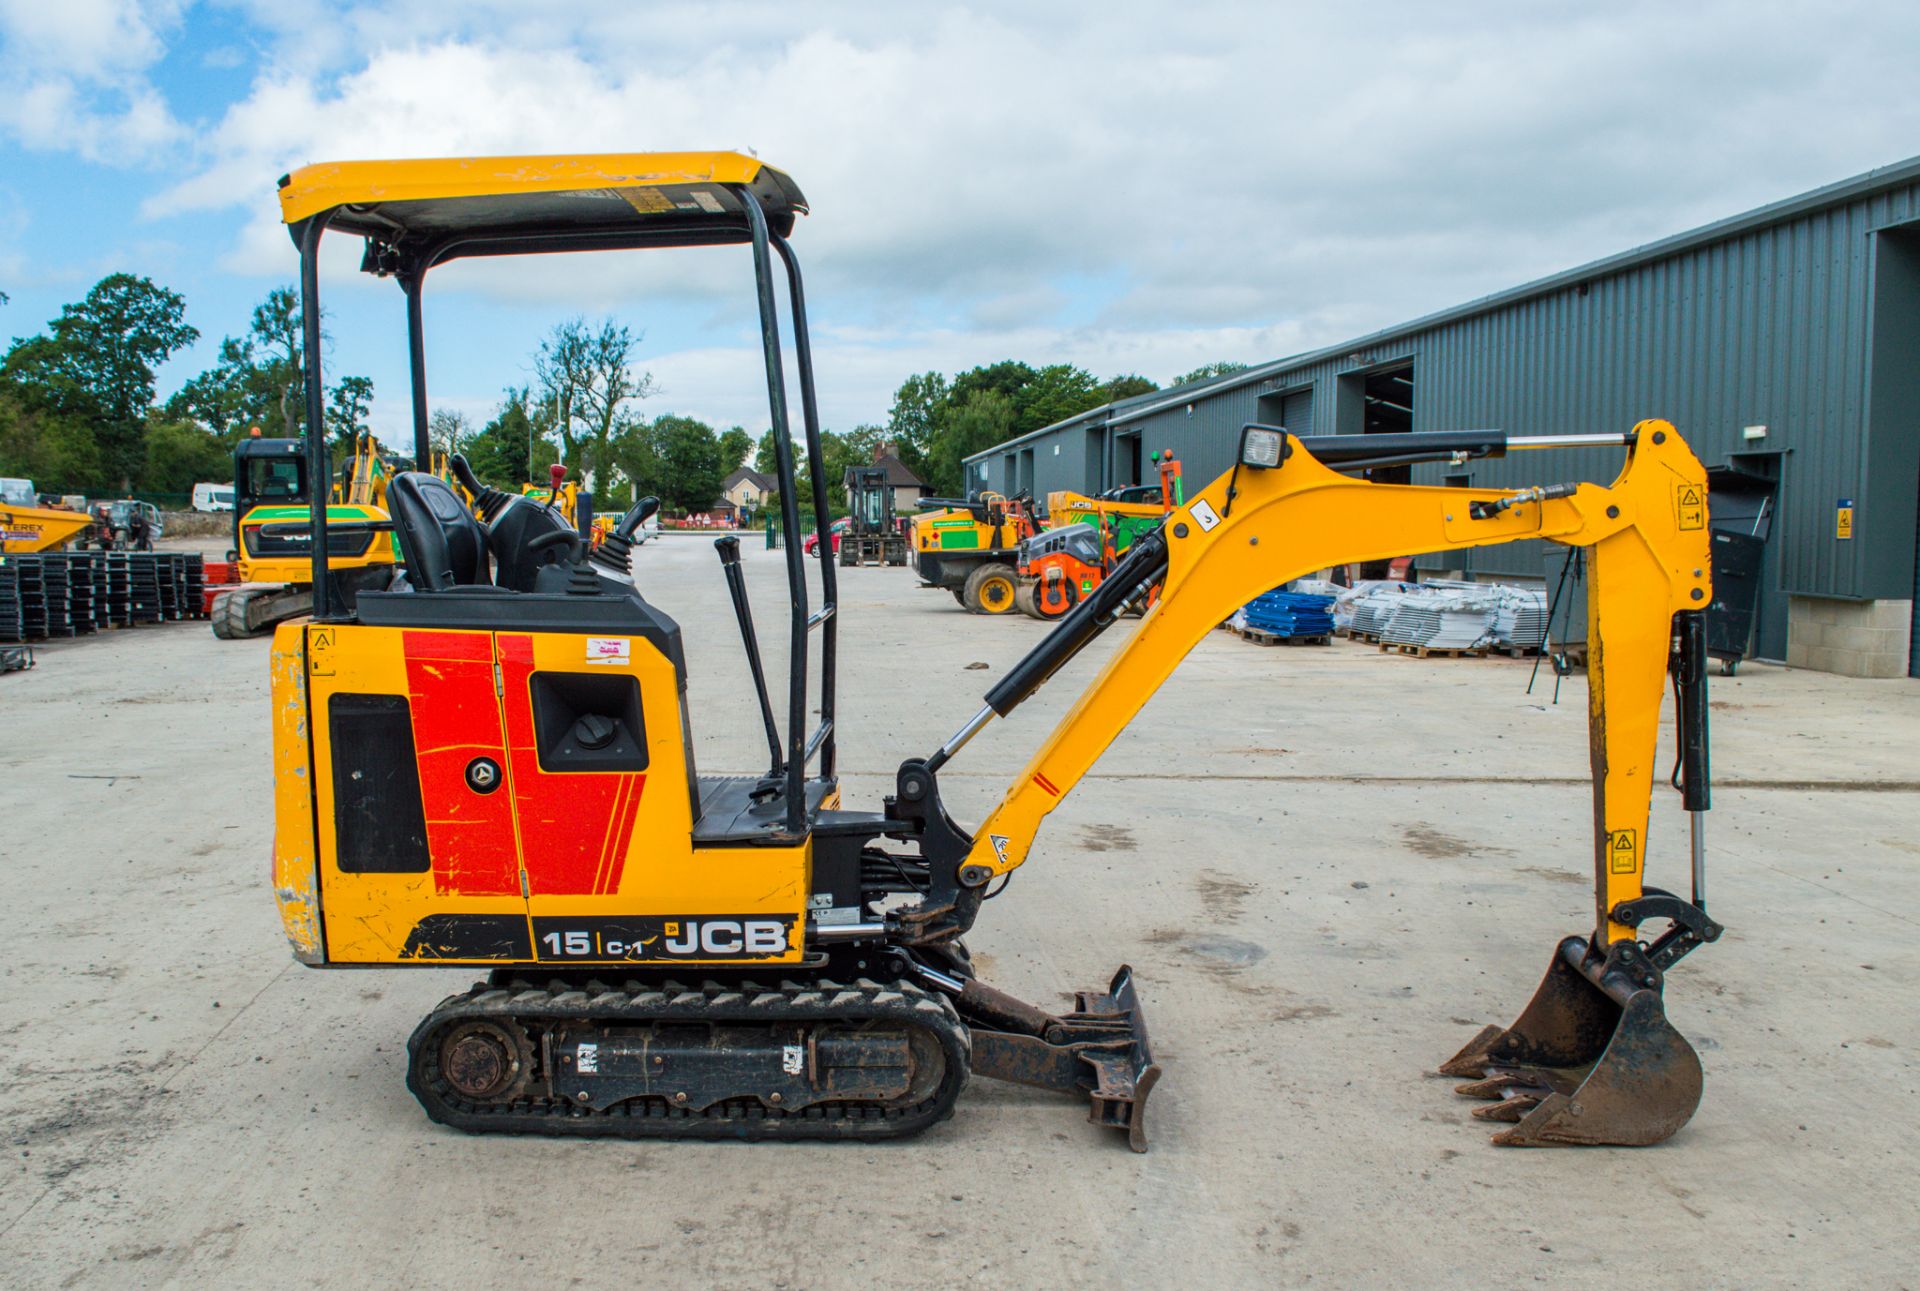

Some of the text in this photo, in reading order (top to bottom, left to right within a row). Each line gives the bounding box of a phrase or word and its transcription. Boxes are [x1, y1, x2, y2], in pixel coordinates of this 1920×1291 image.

[7, 523, 44, 531] TEREX
[543, 931, 591, 955] 15
[665, 921, 786, 954] JCB
